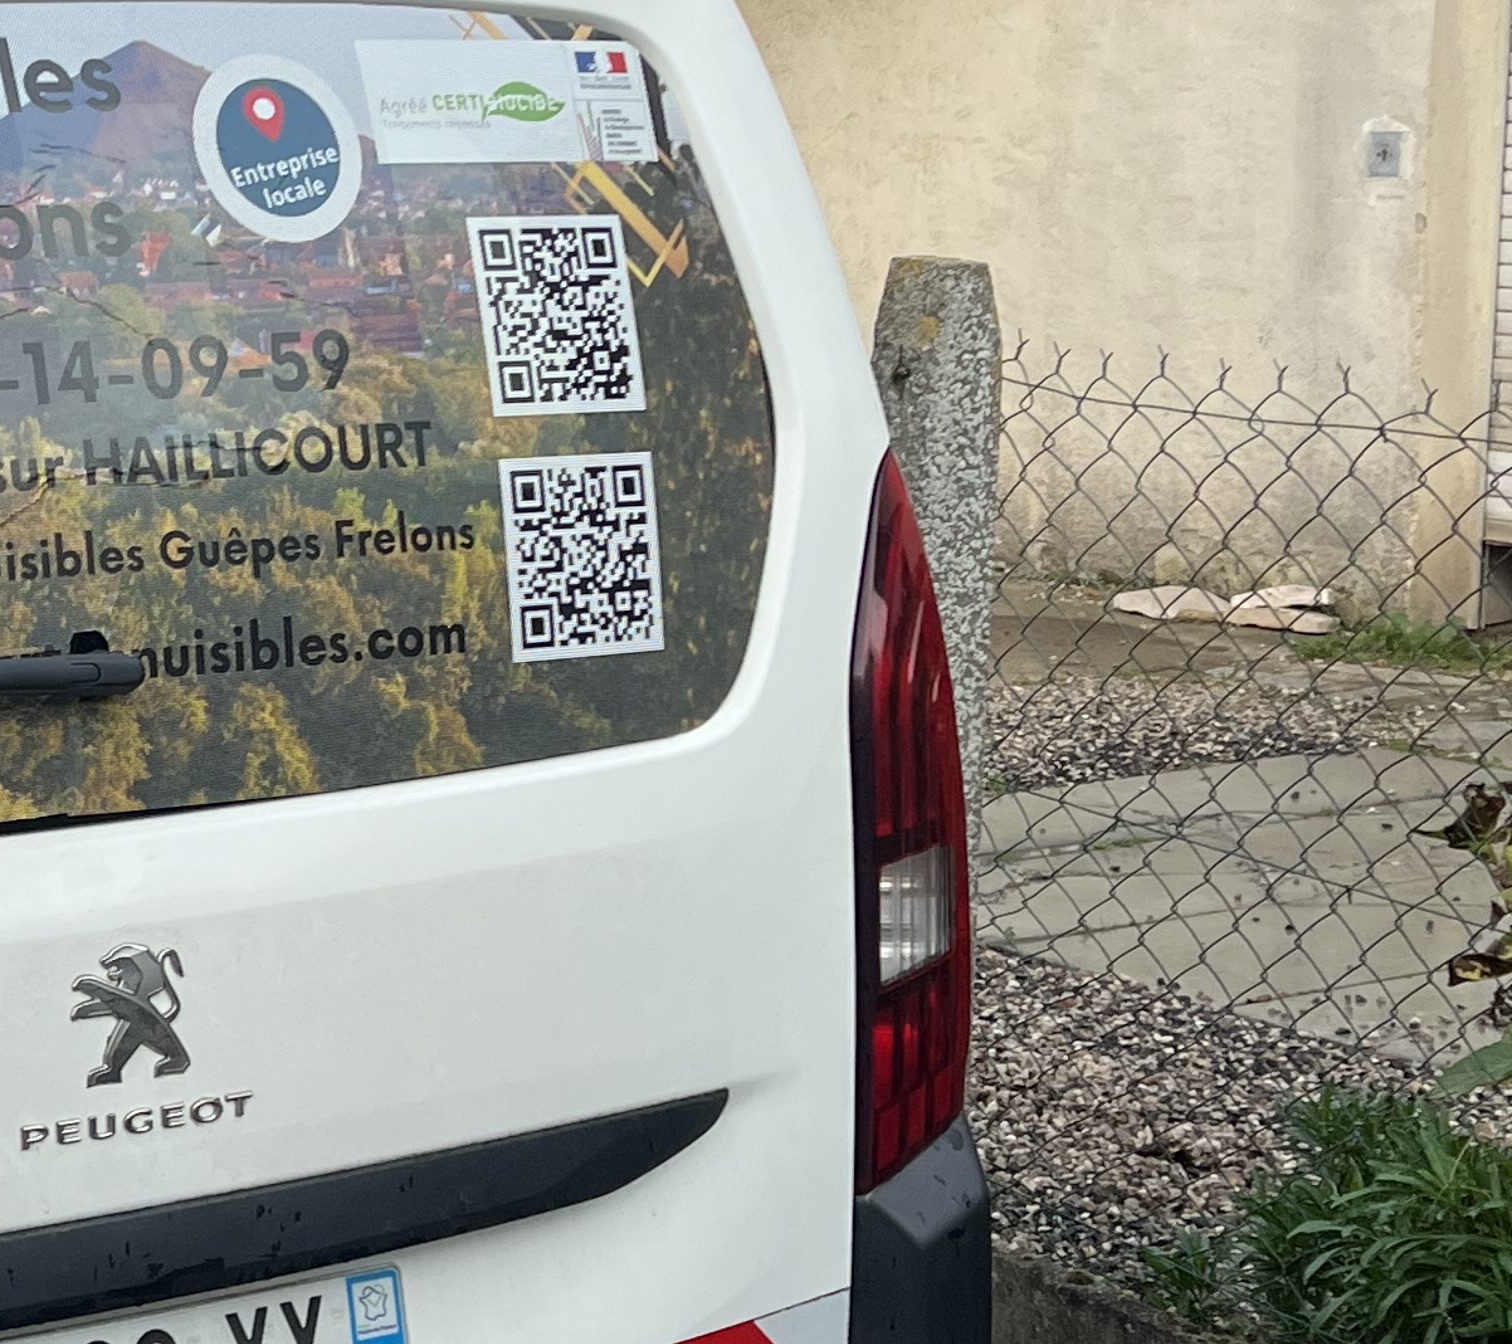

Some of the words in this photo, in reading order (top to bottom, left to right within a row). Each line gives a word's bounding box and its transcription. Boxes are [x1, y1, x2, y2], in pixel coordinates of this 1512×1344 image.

[230, 145, 340, 189] Entreprise
[262, 176, 326, 210] locale
[83, 420, 432, 485] HAILLICOURT
[160, 529, 320, 579] Guêpes
[336, 511, 475, 556] Frelons
[131, 616, 467, 680] nuisibles.com
[19, 1090, 255, 1152] PEUGEOT
